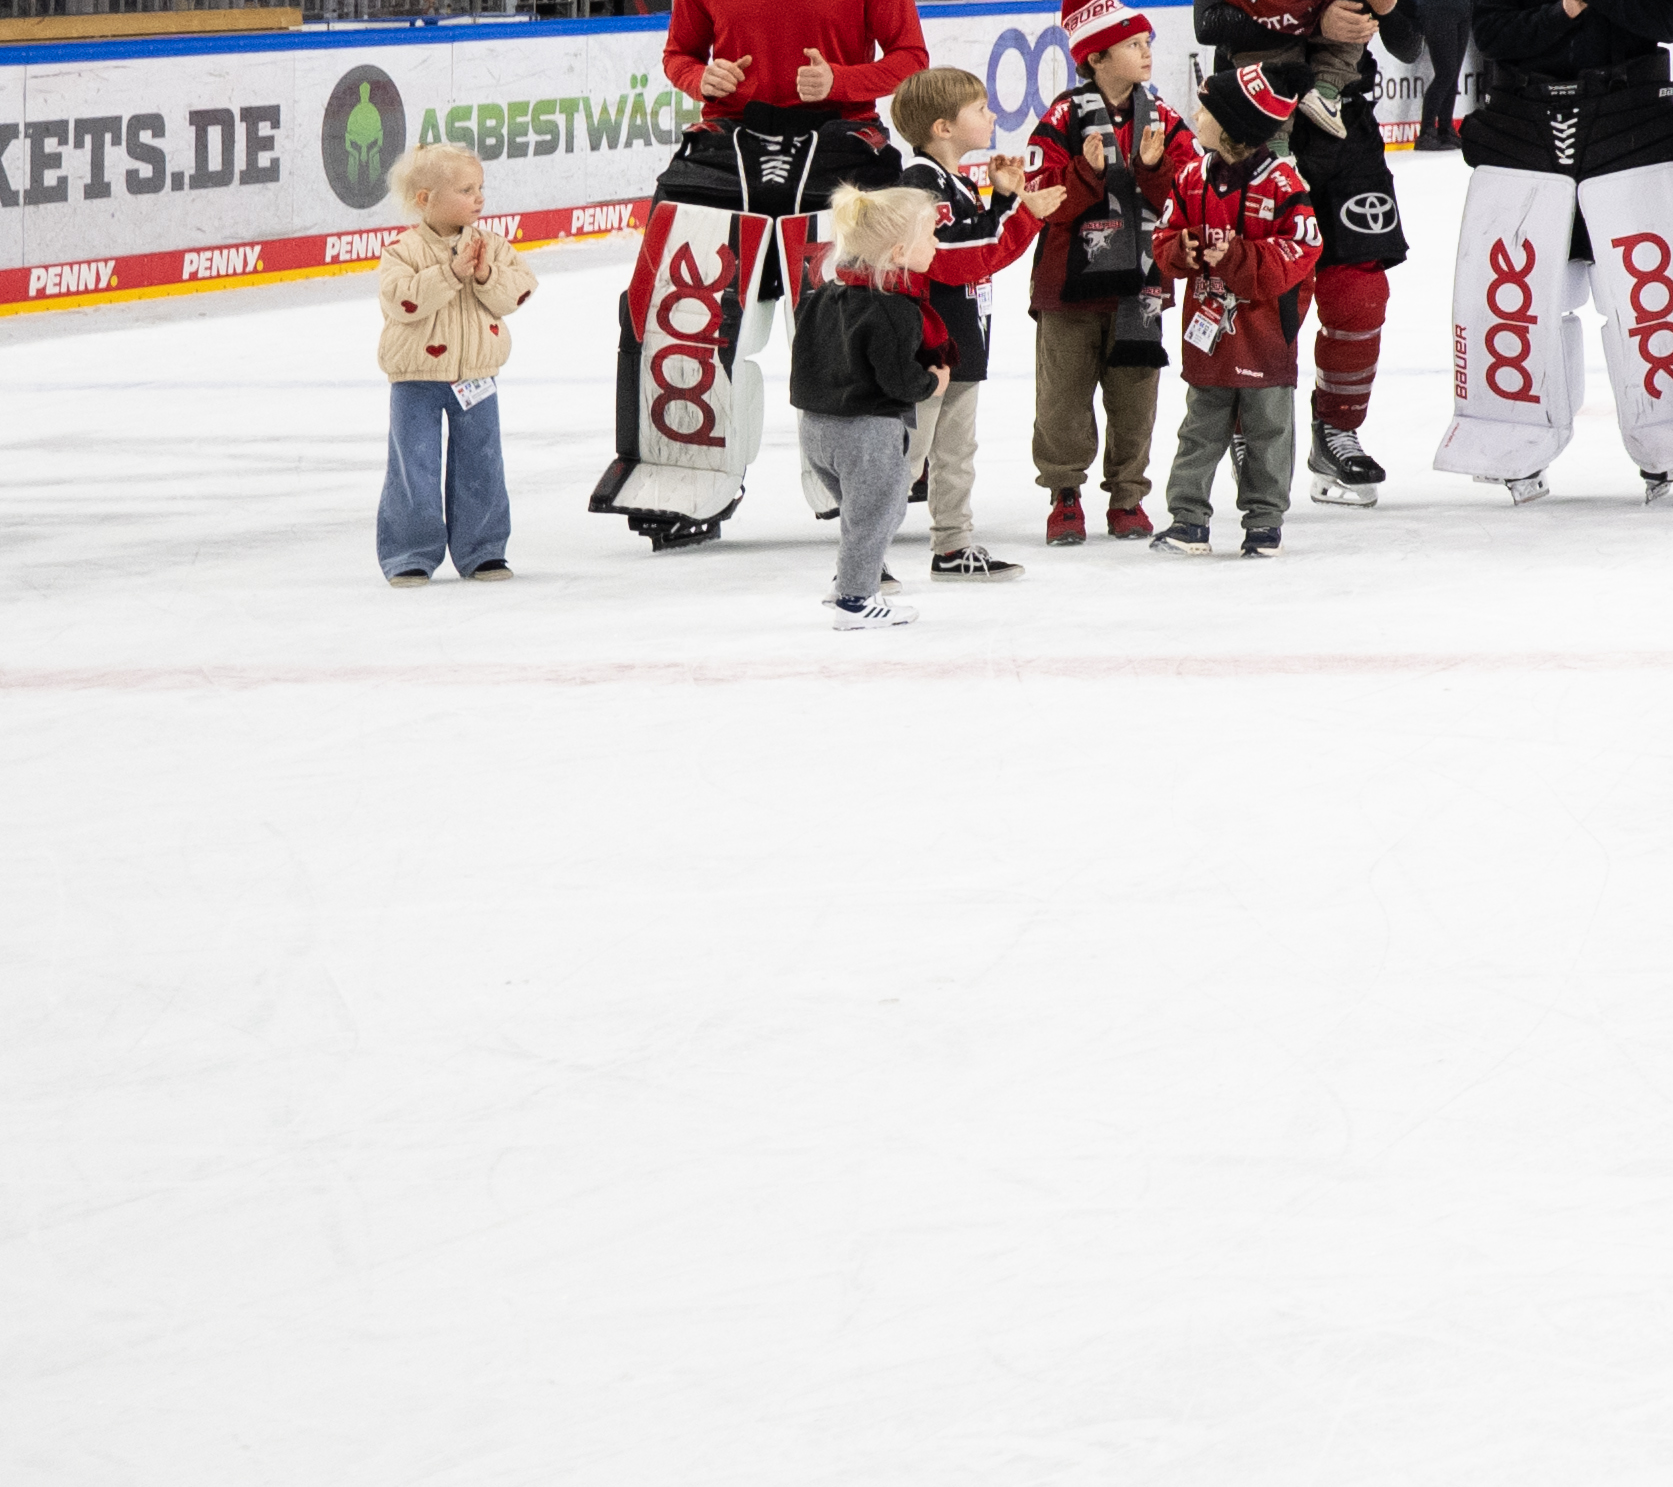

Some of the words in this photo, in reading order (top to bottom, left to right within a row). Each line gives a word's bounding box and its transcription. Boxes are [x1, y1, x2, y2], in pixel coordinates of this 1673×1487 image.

[1374, 71, 1425, 101] Bonn
[1293, 214, 1323, 248] 10
[1455, 324, 1468, 401] BAUER
